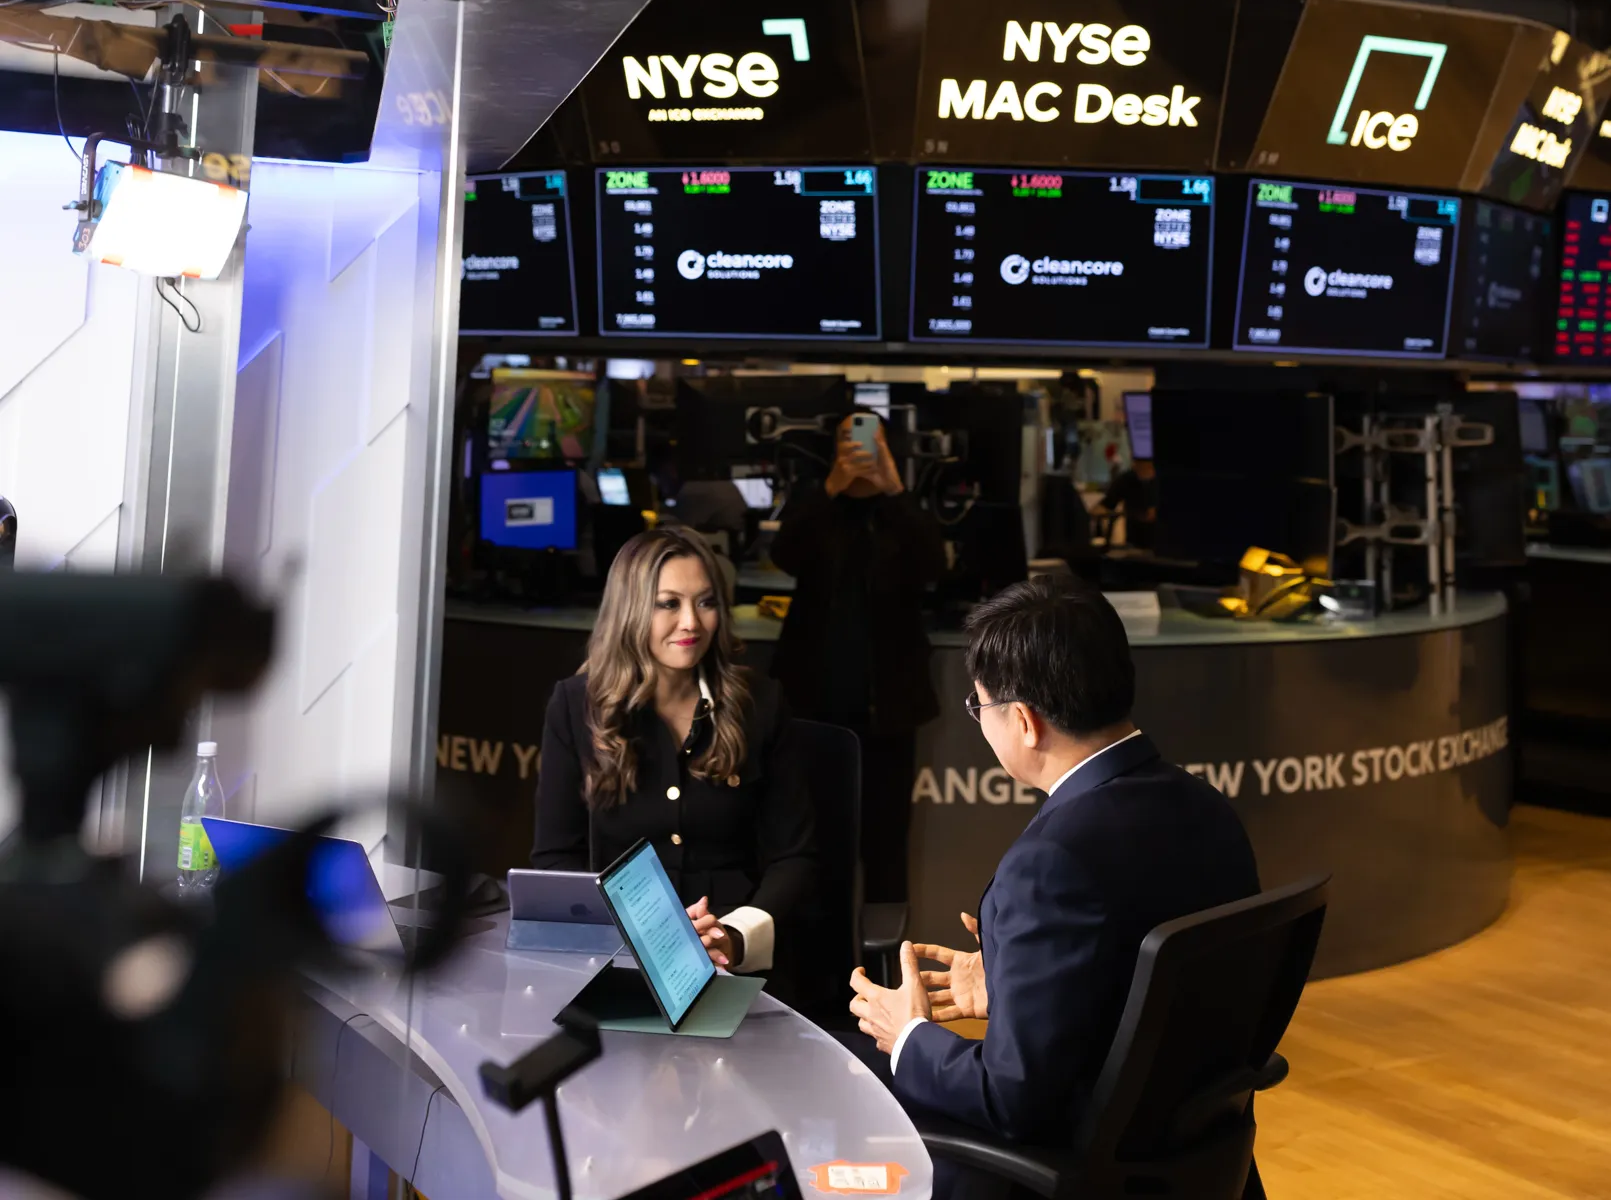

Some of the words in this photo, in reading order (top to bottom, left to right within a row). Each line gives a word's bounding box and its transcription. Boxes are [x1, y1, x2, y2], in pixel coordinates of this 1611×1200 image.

[938, 78, 1062, 122] MAC
[1074, 85, 1201, 127] Desk
[606, 171, 649, 188] ZONE
[926, 171, 974, 189] ZONE
[706, 251, 793, 268] cleancore
[1032, 256, 1124, 276] cleancore
[436, 734, 503, 775] NEW
[1252, 753, 1346, 795] YORK
[1352, 738, 1436, 786] STOCK
[912, 767, 1037, 805] ANGE
